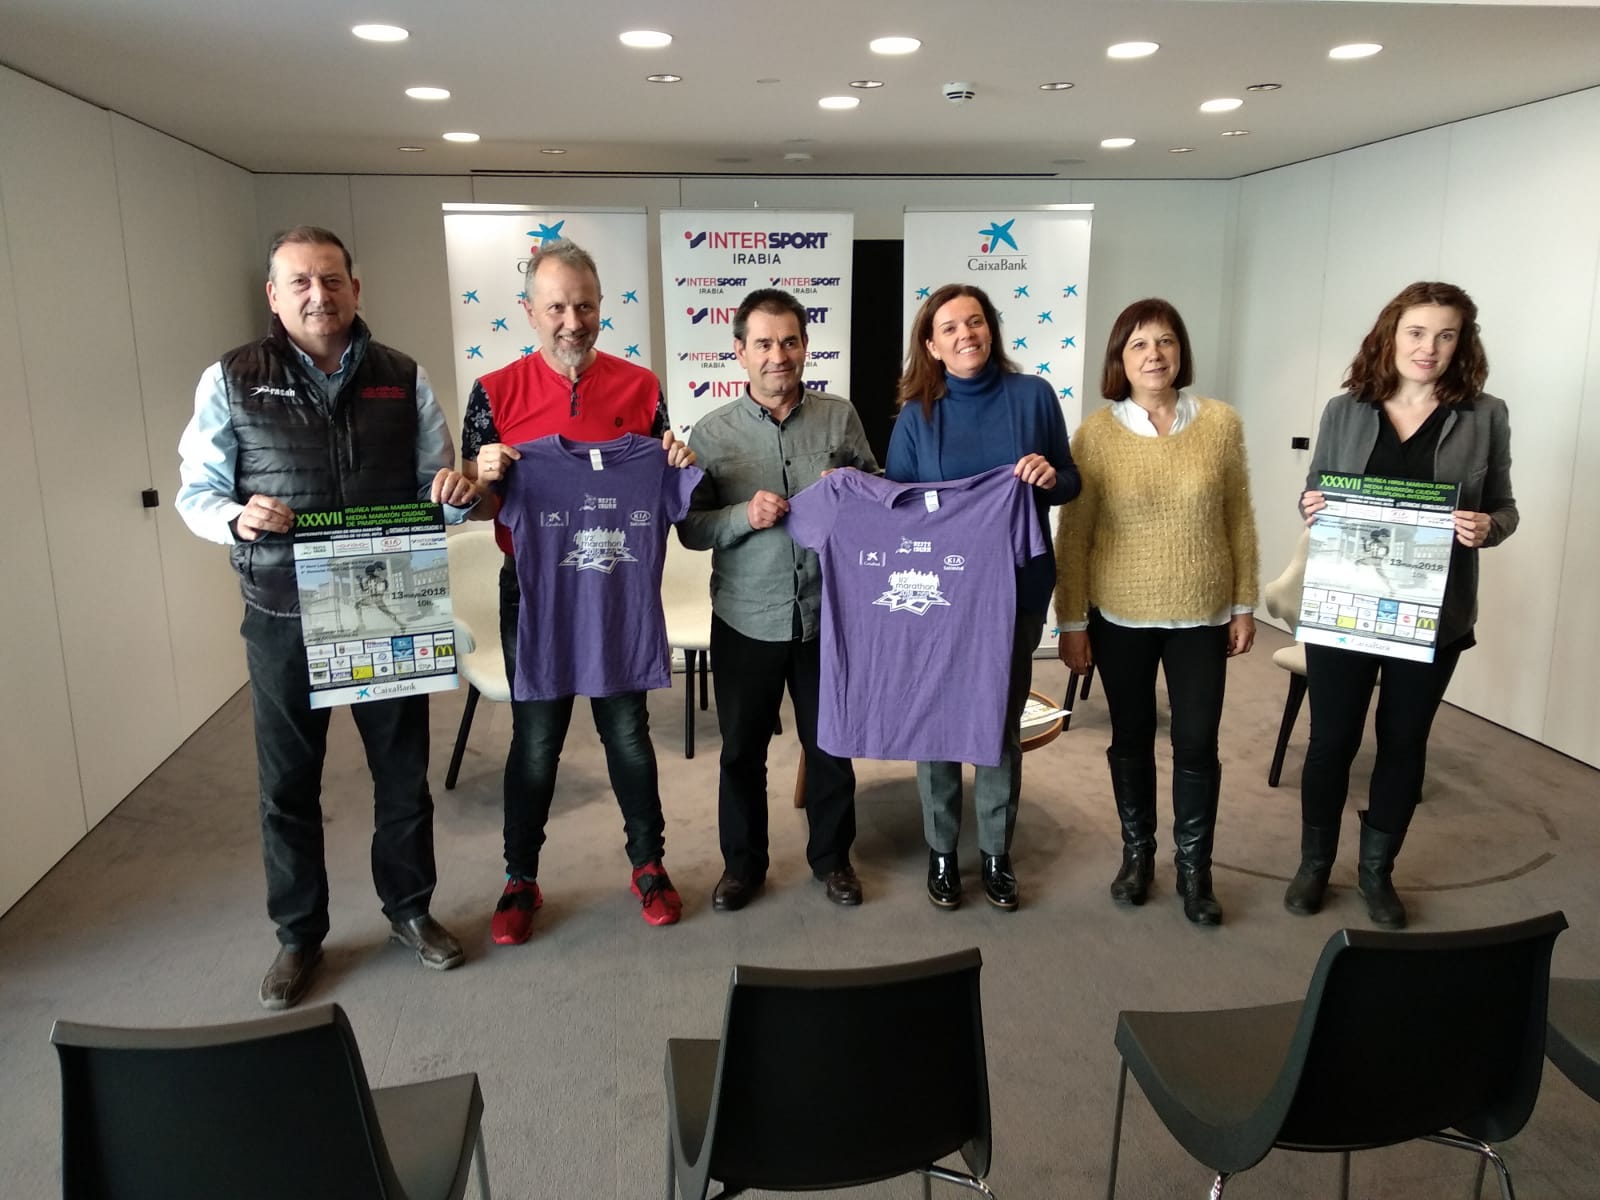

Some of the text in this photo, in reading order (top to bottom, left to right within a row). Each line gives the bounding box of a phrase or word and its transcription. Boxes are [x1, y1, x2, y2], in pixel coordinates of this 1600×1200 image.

[708, 231, 829, 249] INTERSPORT
[733, 253, 782, 265] IRABIA
[967, 258, 1028, 271] CaixaBank
[686, 277, 748, 287] INTERSPORT
[780, 277, 841, 287] INTERSPORT
[688, 351, 737, 361] INTERSPO
[1320, 474, 1361, 491] XXXVII
[296, 511, 343, 528] XXXVII
[581, 540, 622, 548] marathon
[895, 583, 936, 591] marathon
[372, 682, 417, 696] CaixaBank
